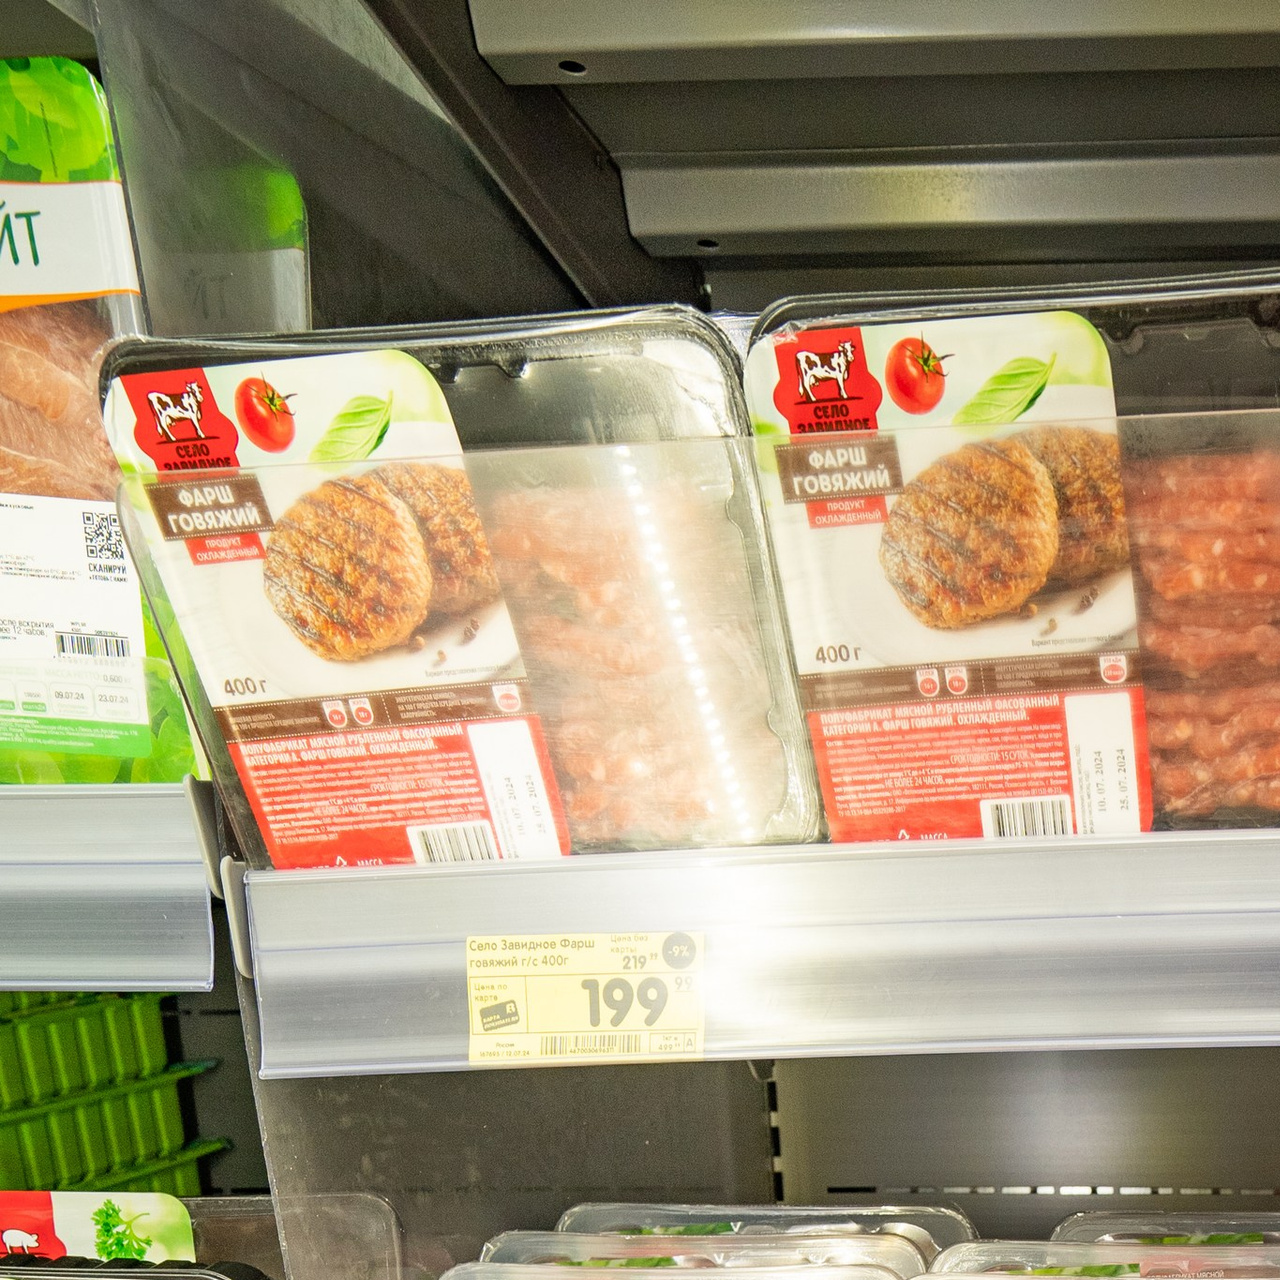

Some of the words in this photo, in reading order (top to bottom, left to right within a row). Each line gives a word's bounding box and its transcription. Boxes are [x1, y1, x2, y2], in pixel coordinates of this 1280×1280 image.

[814, 405, 849, 419] СЕЛО
[809, 447, 867, 469] ФАРШ
[793, 465, 890, 494] ГОВЯЖИЙ
[178, 486, 234, 507] ФАРШ
[168, 502, 262, 533] ГОВЯЖИЙ
[623, 955, 646, 970] 219
[581, 977, 669, 1028] 199
